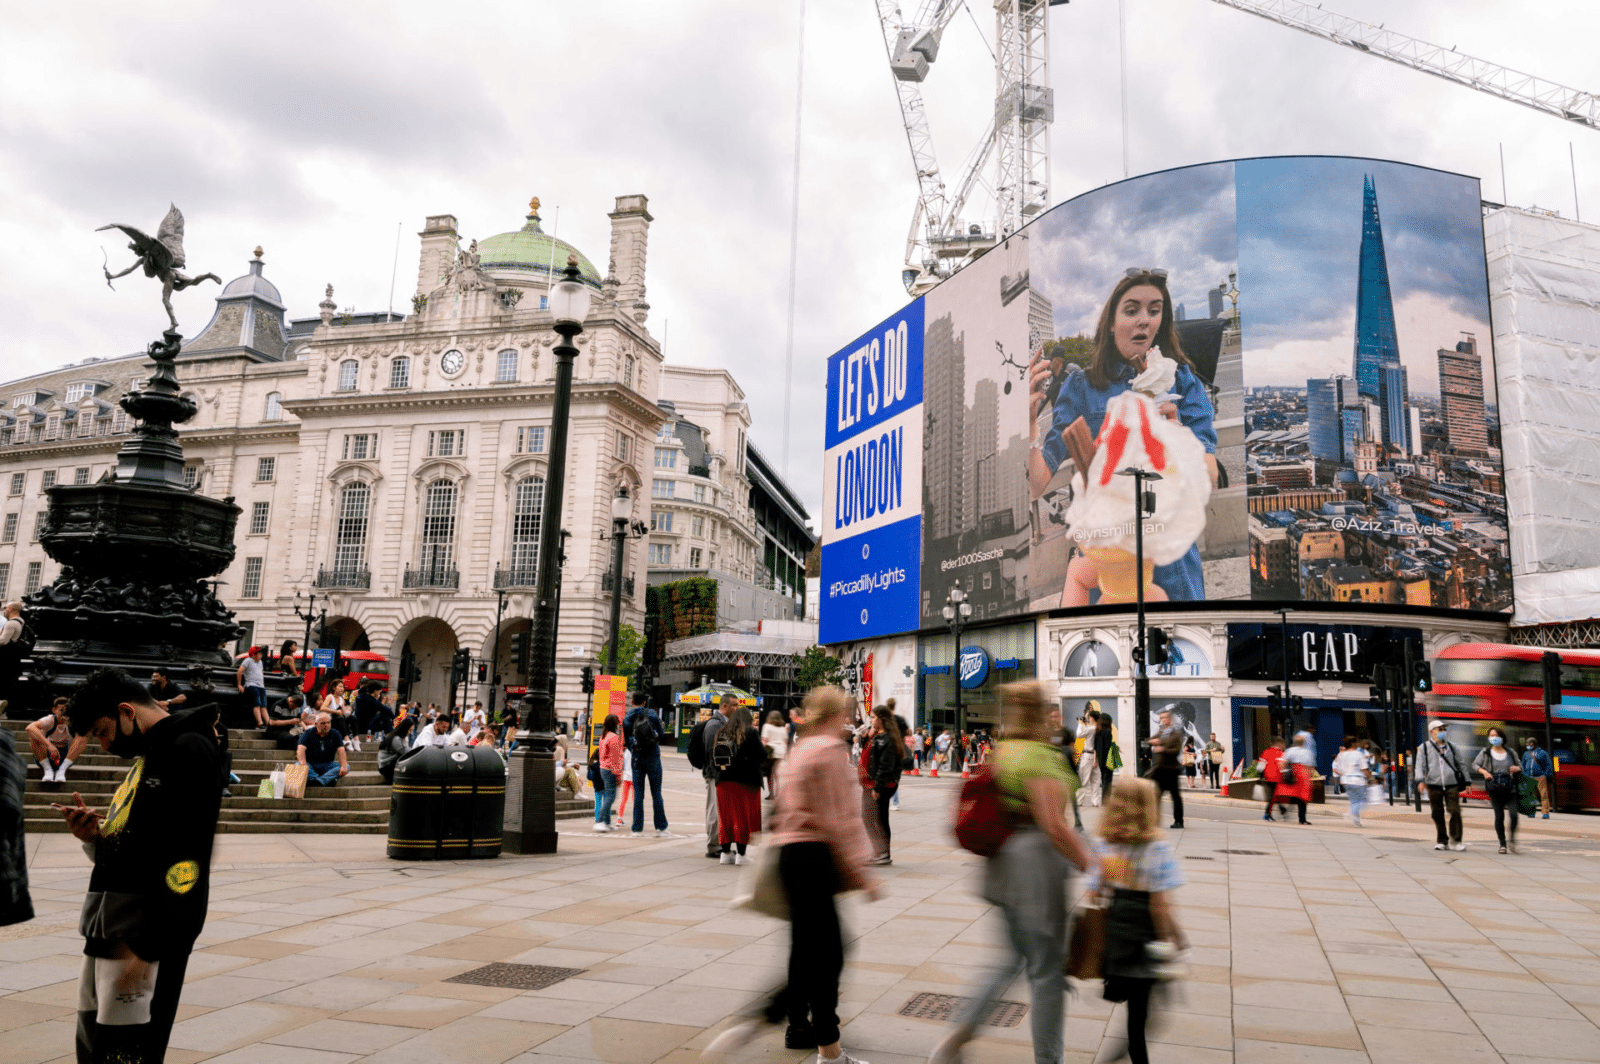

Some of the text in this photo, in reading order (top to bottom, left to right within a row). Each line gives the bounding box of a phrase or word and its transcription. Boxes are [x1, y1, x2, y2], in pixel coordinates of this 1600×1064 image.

[838, 319, 908, 433] LET'S DO
[835, 425, 903, 530] LONDON
[1073, 522, 1165, 543] @lynsmillian
[1331, 516, 1445, 537] @Aziz_Travels
[940, 547, 1004, 572] @der1000Sascha
[829, 567, 906, 599] #PiccadillyLights
[960, 652, 982, 681] Boots
[1302, 631, 1359, 673] GAP
